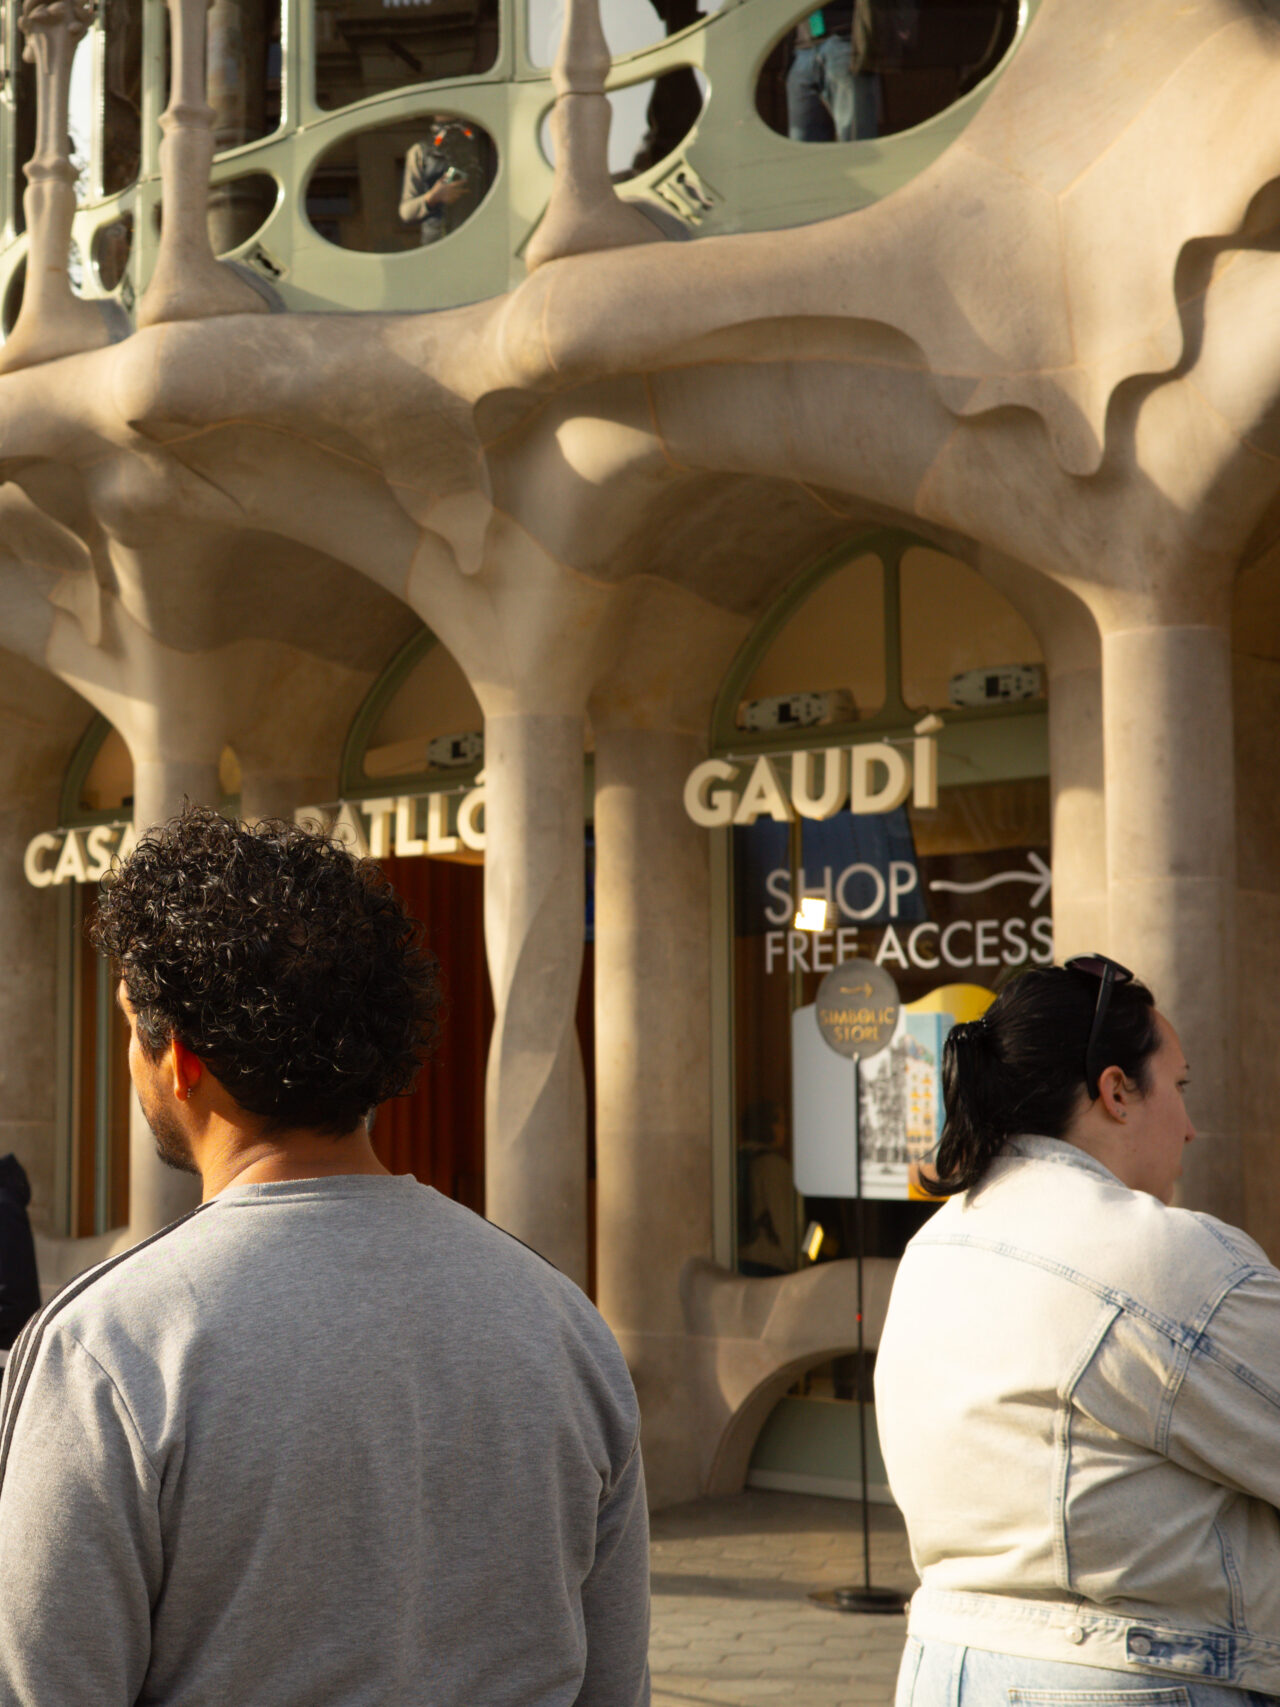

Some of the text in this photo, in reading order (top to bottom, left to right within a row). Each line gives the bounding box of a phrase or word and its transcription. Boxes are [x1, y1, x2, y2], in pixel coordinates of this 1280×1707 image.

[683, 713, 944, 828] GAUDÍ
[765, 860, 917, 925] SHOP
[875, 916, 1054, 970] ACCESS
